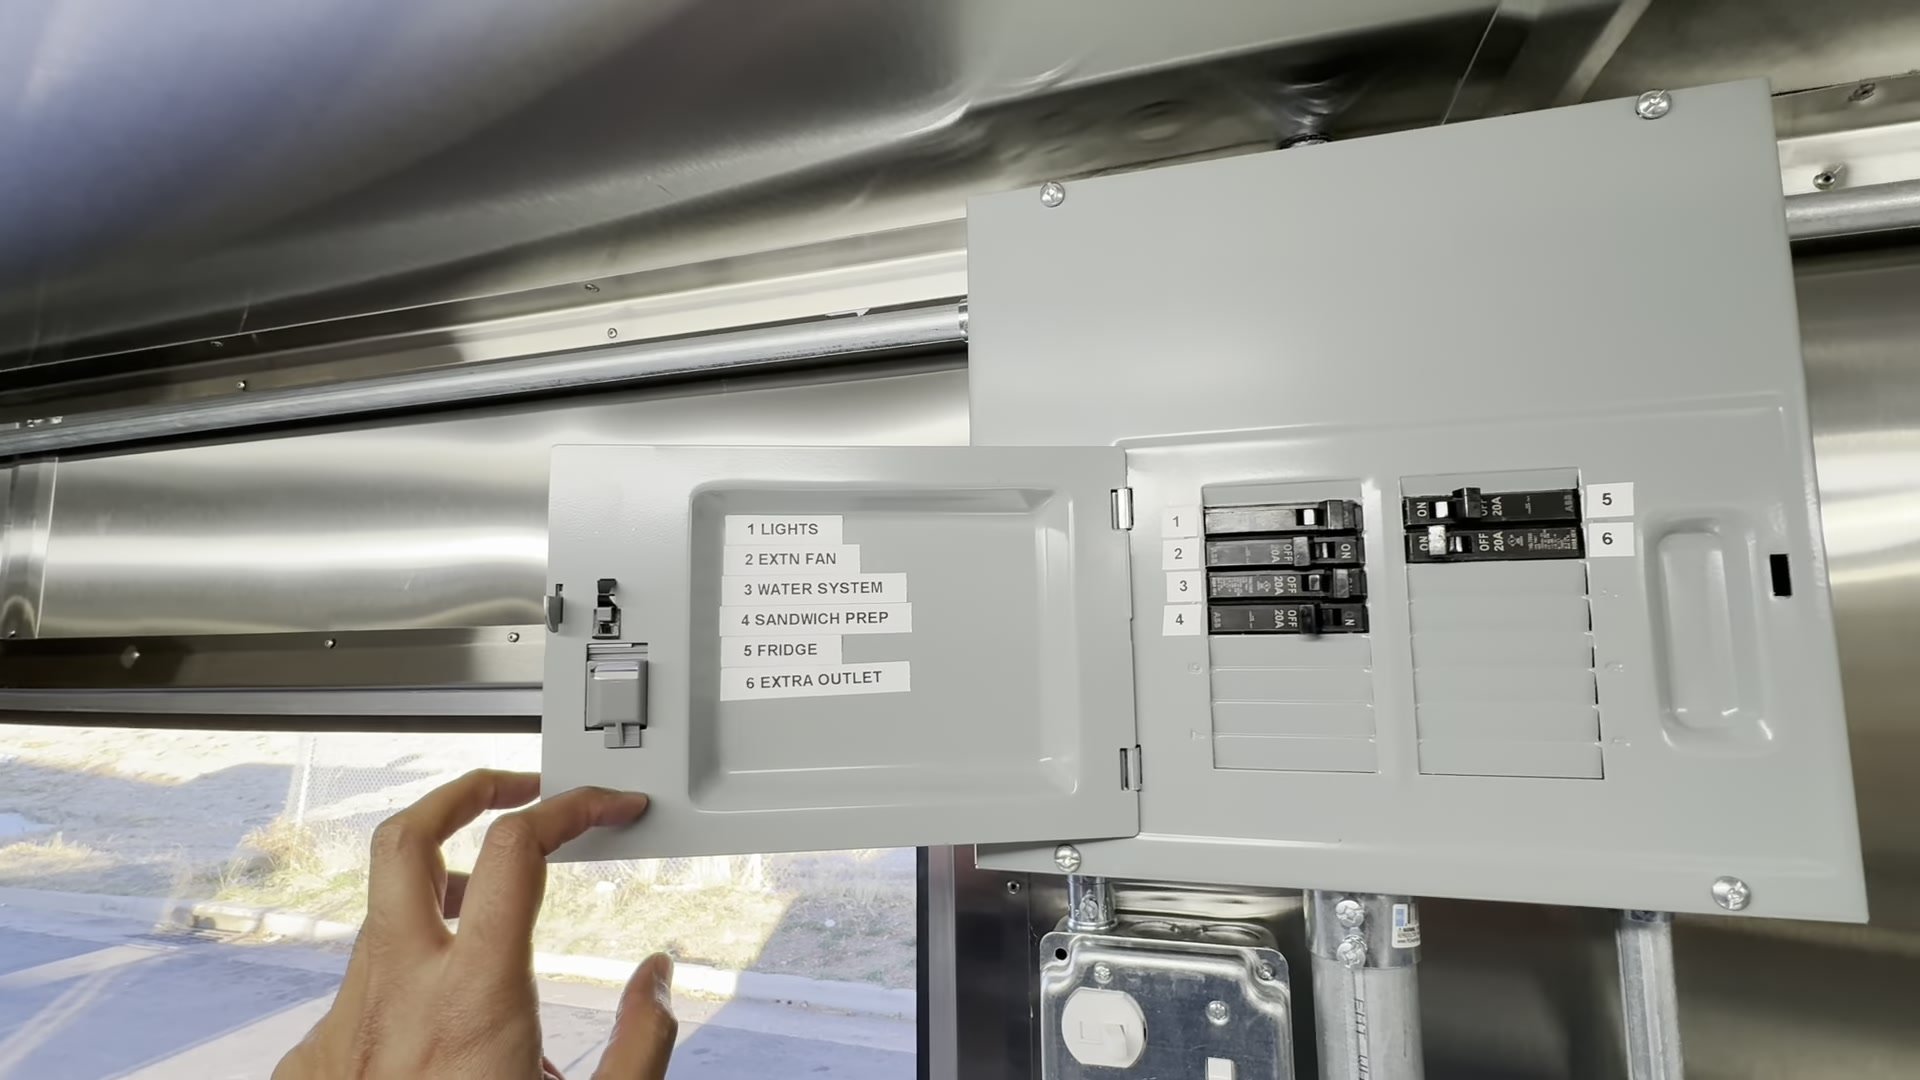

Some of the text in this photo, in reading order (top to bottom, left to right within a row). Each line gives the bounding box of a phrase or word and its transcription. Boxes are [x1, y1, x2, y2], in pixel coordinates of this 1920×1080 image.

[1491, 497, 1503, 516] 20A
[1602, 492, 1613, 506] 5
[1416, 501, 1427, 517] ON
[1172, 515, 1179, 527] 1
[747, 523, 819, 535] 1 LIGHTS
[1419, 536, 1429, 551] ON
[1478, 533, 1490, 552] OFF
[1492, 531, 1505, 552] 20A
[1602, 532, 1613, 545] 6
[1174, 547, 1183, 560] 2
[1270, 544, 1280, 563] 20A
[1283, 544, 1293, 562] OFF
[1340, 543, 1352, 559] ON
[744, 552, 837, 566] 2 EXTN FAN
[744, 581, 883, 596] 3 WATER SYSTEM
[1179, 580, 1188, 592] 3
[1273, 576, 1284, 596] 20A
[1286, 576, 1297, 594] OFF
[741, 611, 889, 626] 4 SANDWICH PREP
[1175, 613, 1184, 625] 4
[1274, 610, 1285, 629] 20A
[1287, 610, 1298, 628] OFF
[1344, 611, 1356, 626] ON
[743, 643, 818, 657] 5 FRIDGE
[746, 670, 882, 689] 6 EXTRA OUTLET
